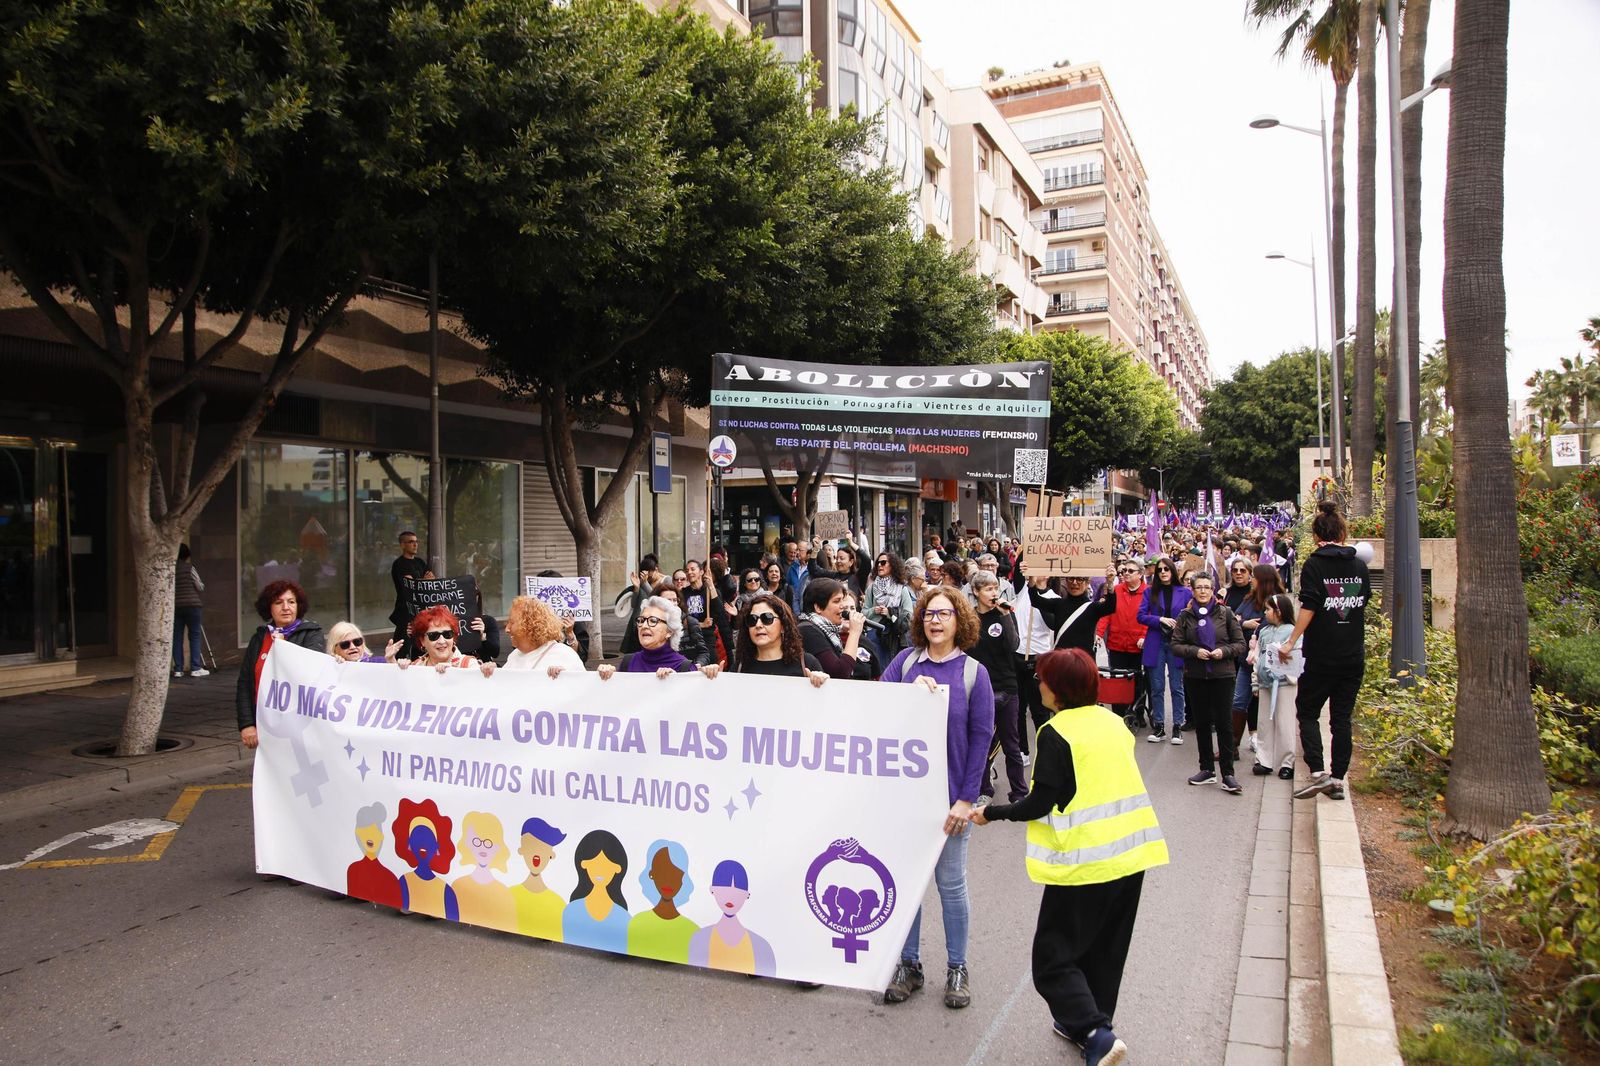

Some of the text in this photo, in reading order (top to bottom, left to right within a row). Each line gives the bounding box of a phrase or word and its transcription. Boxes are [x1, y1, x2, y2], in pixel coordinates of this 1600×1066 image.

[714, 394, 750, 403] Género
[762, 396, 829, 406] Prostitución
[924, 402, 973, 410] Vientres
[978, 403, 990, 411] de
[996, 403, 1042, 414] alquiler
[770, 422, 799, 430] CONTRA
[801, 423, 826, 432] TODAS
[844, 425, 893, 434] VIOLENCIAS
[941, 429, 980, 438] MUJERES
[983, 431, 1038, 441] (FEMINISMO)
[776, 438, 969, 456] ERES PARTE DEL PROBLEMA (MACHISMO)
[1061, 520, 1081, 531] NO
[1088, 519, 1110, 531] ERA
[1028, 533, 1093, 543] UNA ZORRA
[1027, 545, 1037, 555] EL
[1039, 543, 1079, 556] CABRÓN
[1046, 557, 1072, 573] TÚ
[418, 579, 457, 591] ATREVES
[528, 578, 542, 587] EL
[418, 590, 464, 603] TOCARME
[1324, 595, 1364, 611] BARBARIE
[265, 679, 929, 778] NO MÁS VIOLENCIA CONTRA LAS MUJERES
[382, 750, 710, 813] NI PARAMOS NI CALLAMOS
[807, 882, 828, 923] PLATAFORMA
[828, 921, 852, 933] ACCIÓN
[855, 915, 885, 934] FEMINISTA
